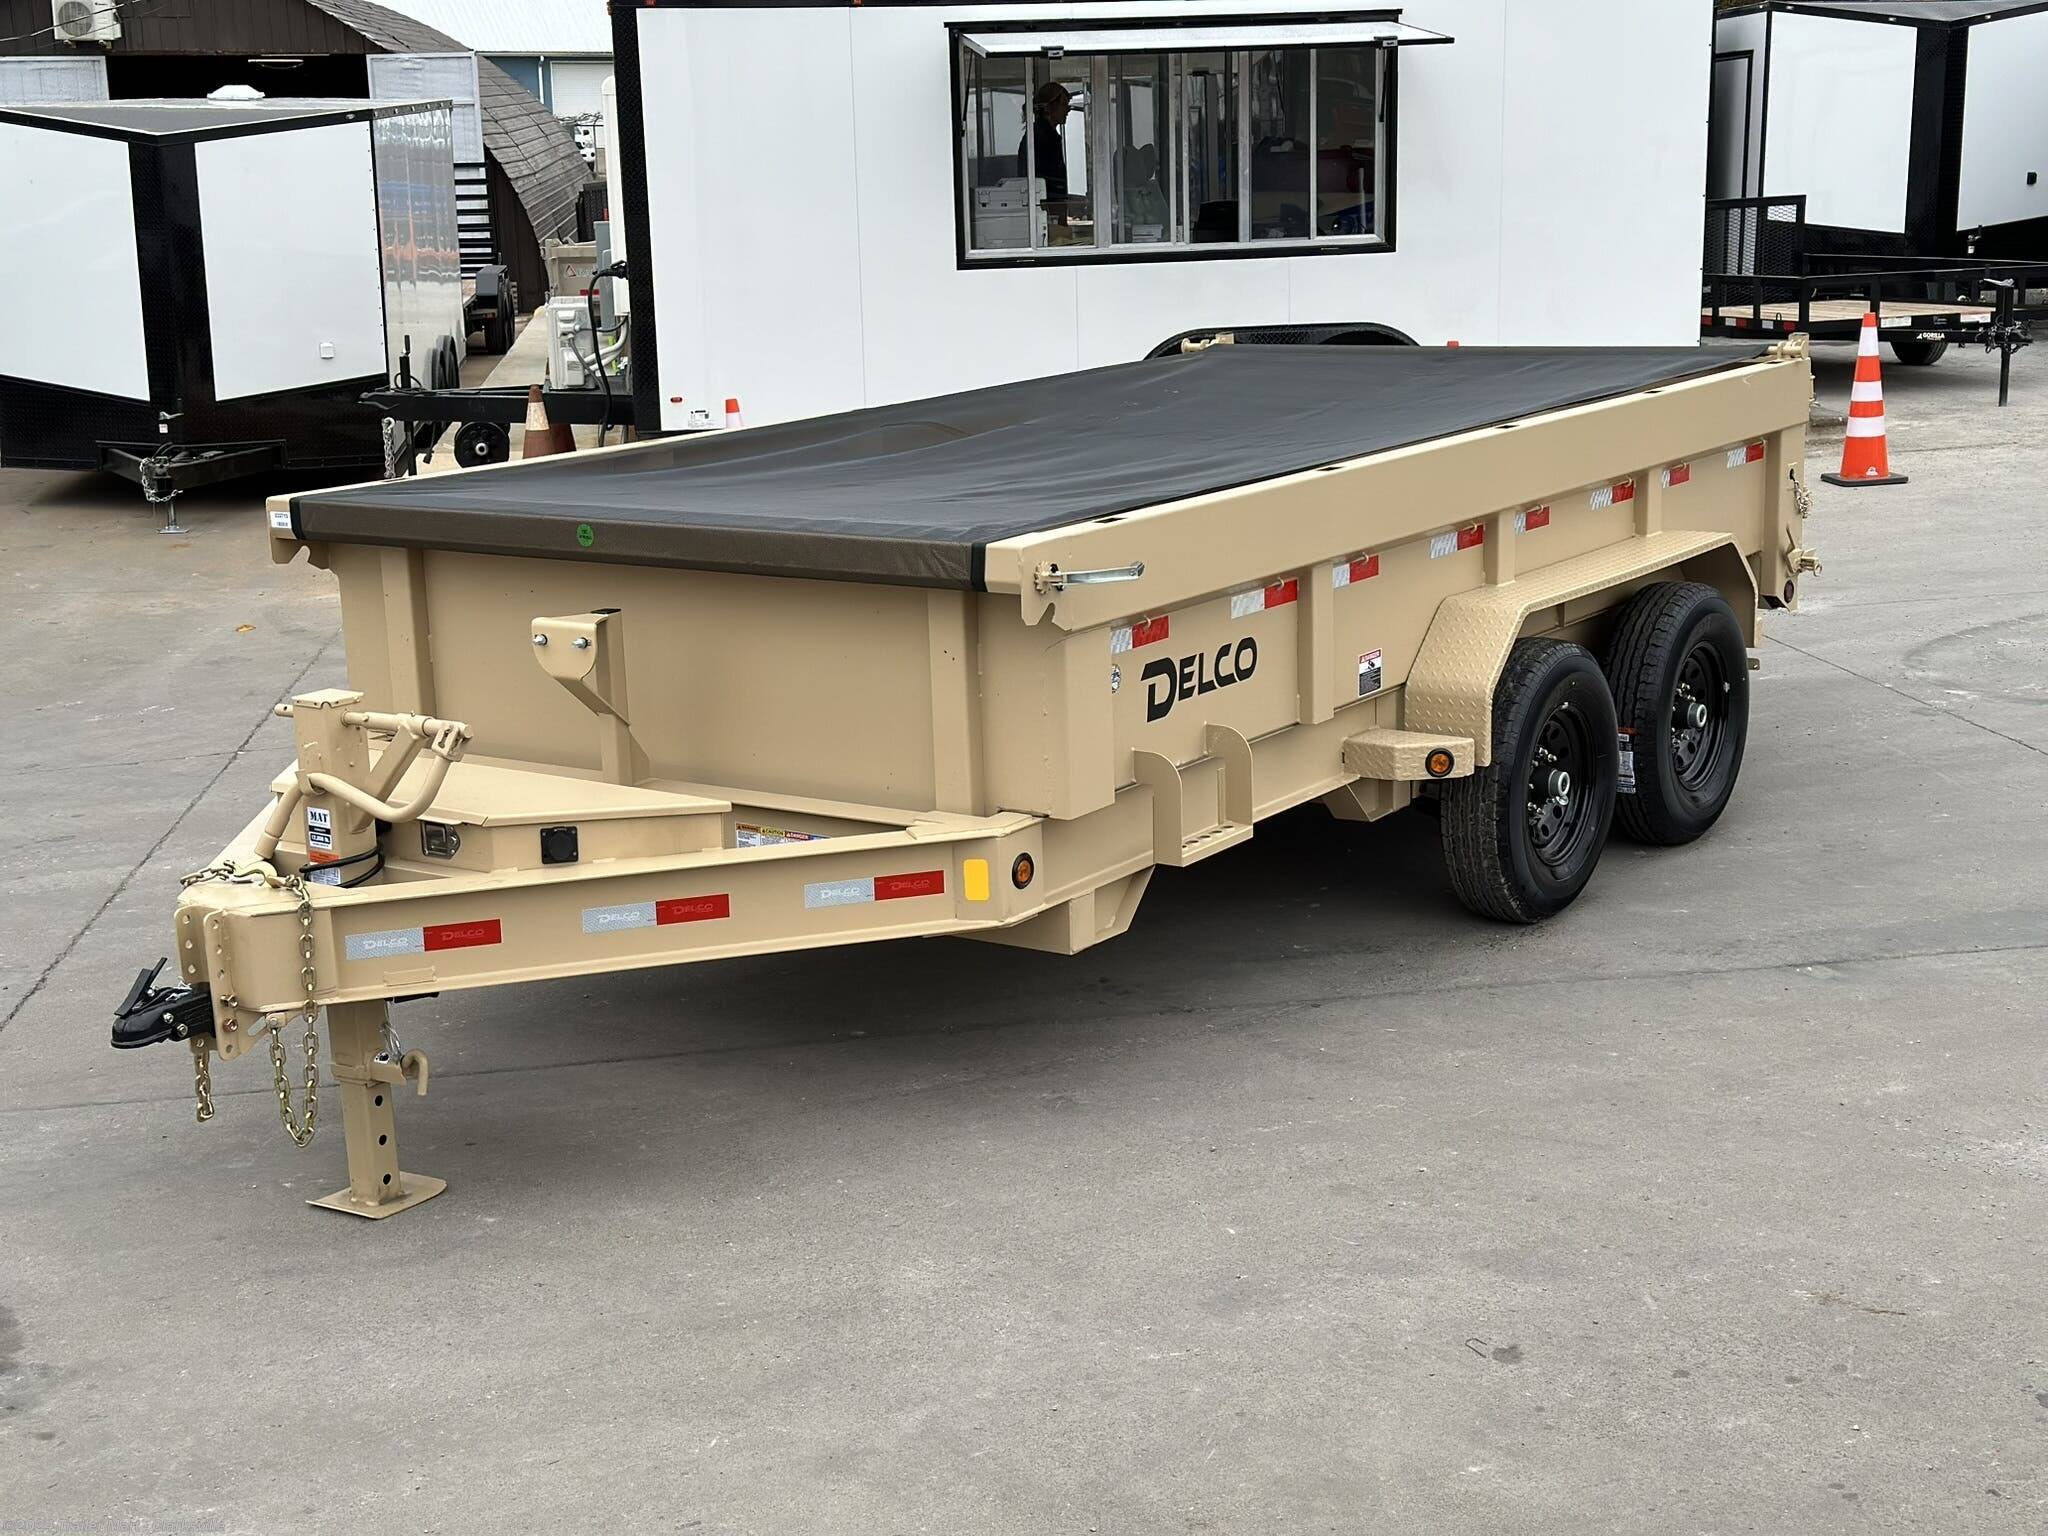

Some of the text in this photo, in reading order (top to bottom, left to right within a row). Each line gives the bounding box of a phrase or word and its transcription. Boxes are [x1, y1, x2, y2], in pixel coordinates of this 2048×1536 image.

[1140, 636, 1258, 723] DELCO
[310, 810, 328, 823] MAT
[765, 828, 784, 836] CAUTION
[889, 879, 930, 891] DELCO
[820, 887, 860, 899] DELCO
[671, 903, 714, 915] DELCO
[598, 911, 640, 923] DELCO
[441, 928, 485, 941] DELCO
[363, 937, 409, 950] DELCO
